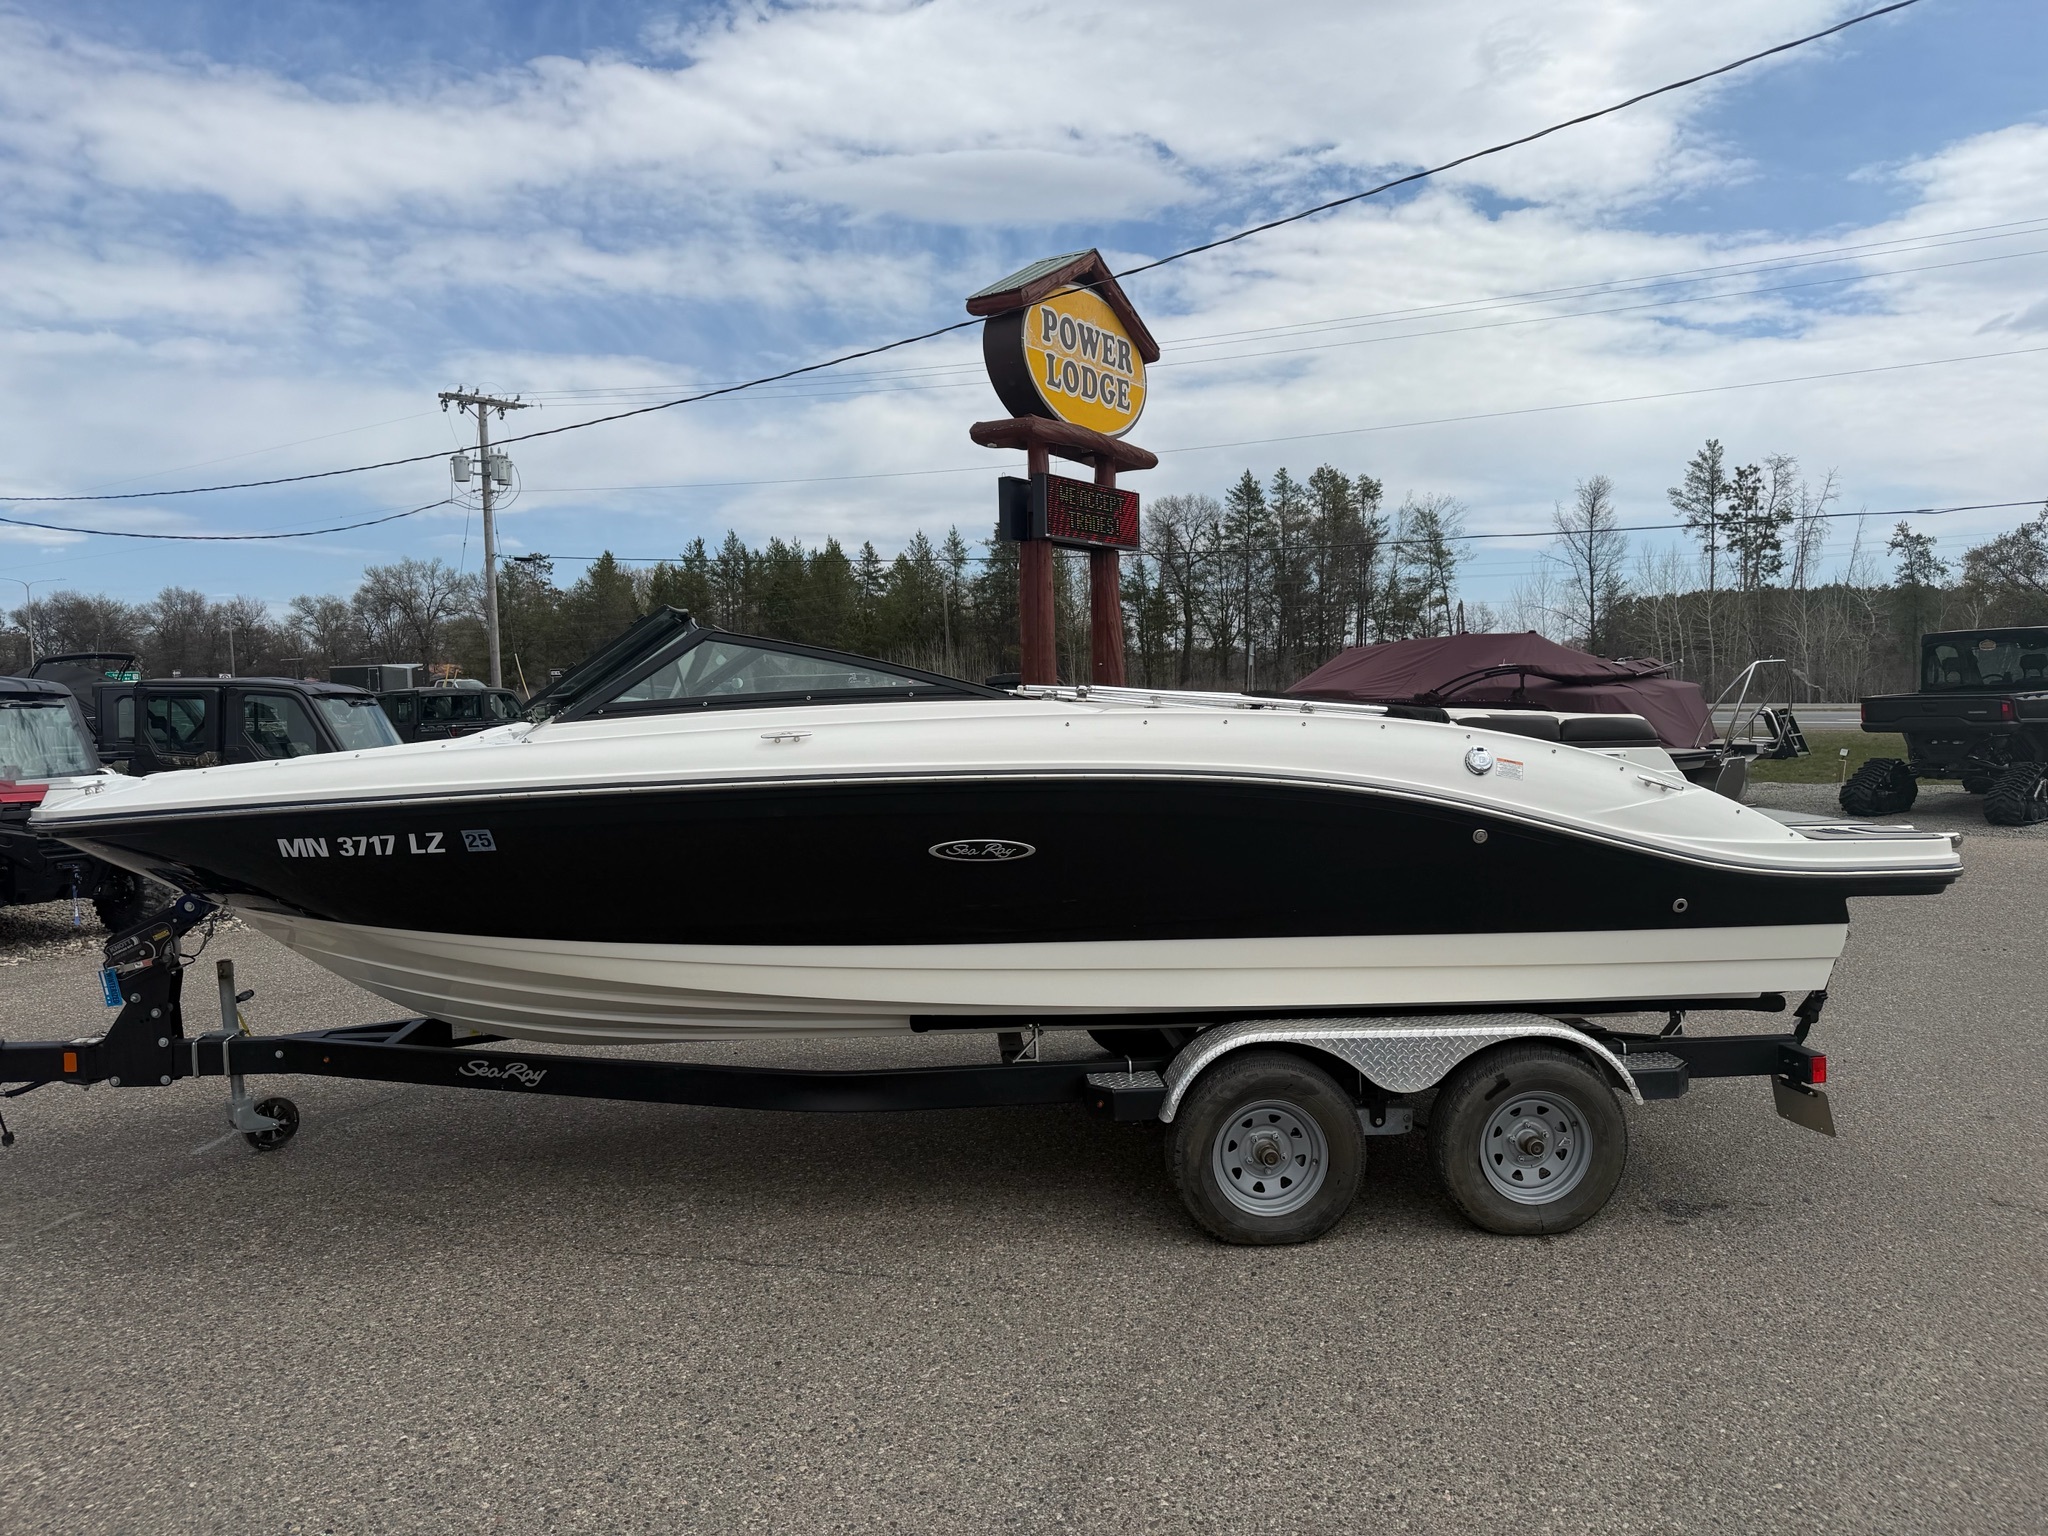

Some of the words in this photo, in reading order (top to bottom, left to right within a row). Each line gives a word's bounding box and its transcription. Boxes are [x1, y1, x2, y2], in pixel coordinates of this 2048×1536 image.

[1041, 306, 1133, 375] POWER
[1046, 352, 1131, 412] LODGE
[1059, 485, 1076, 504] WE
[1079, 490, 1124, 514] ACCEPT
[1068, 511, 1120, 536] TRADES!
[276, 837, 330, 858] MN
[336, 834, 396, 857] 3717
[407, 831, 446, 855] LZ
[465, 833, 492, 848] 25
[945, 844, 980, 856] Sea
[981, 842, 1017, 858] Ray
[108, 939, 132, 954] KNOTT
[458, 1060, 503, 1078] Sea
[502, 1062, 548, 1087] Ray
